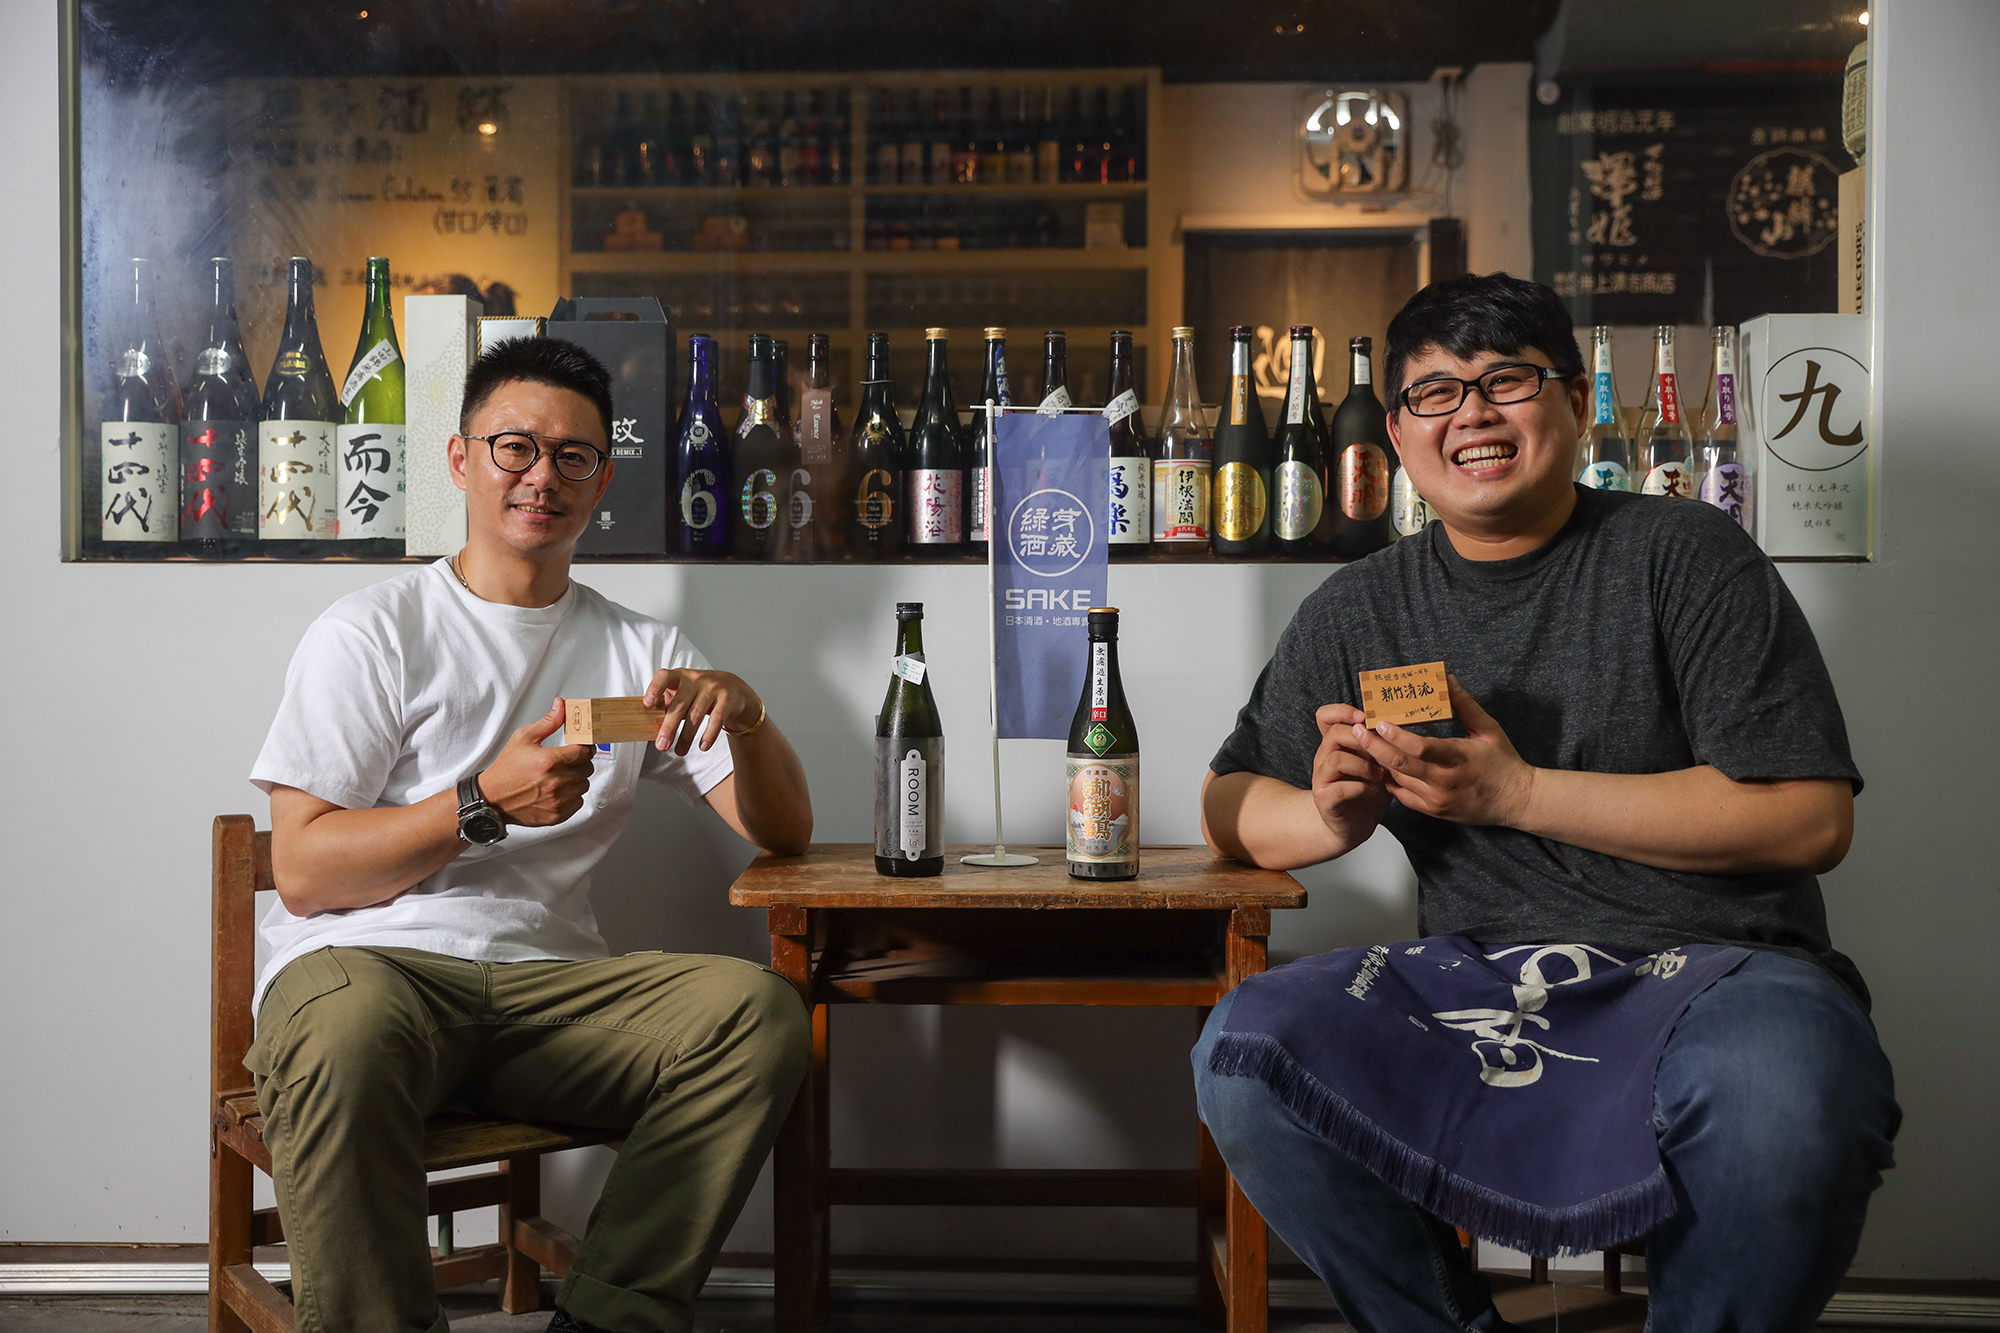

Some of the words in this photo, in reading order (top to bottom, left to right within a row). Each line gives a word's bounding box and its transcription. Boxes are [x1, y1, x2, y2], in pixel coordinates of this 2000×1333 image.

[1771, 359, 1864, 446] 九
[105, 431, 152, 533] 十四代
[184, 428, 231, 530] 十四代
[266, 430, 316, 532] 十四代
[344, 433, 391, 525] 而今
[681, 469, 717, 529] 6
[741, 469, 777, 529] 6
[857, 469, 892, 529] 6
[924, 473, 947, 538] 花陽浴
[1005, 588, 1091, 610] SAKE
[1092, 710, 1107, 719] 辛口
[1380, 681, 1435, 703] 新竹清流
[908, 768, 919, 816] ROOM
